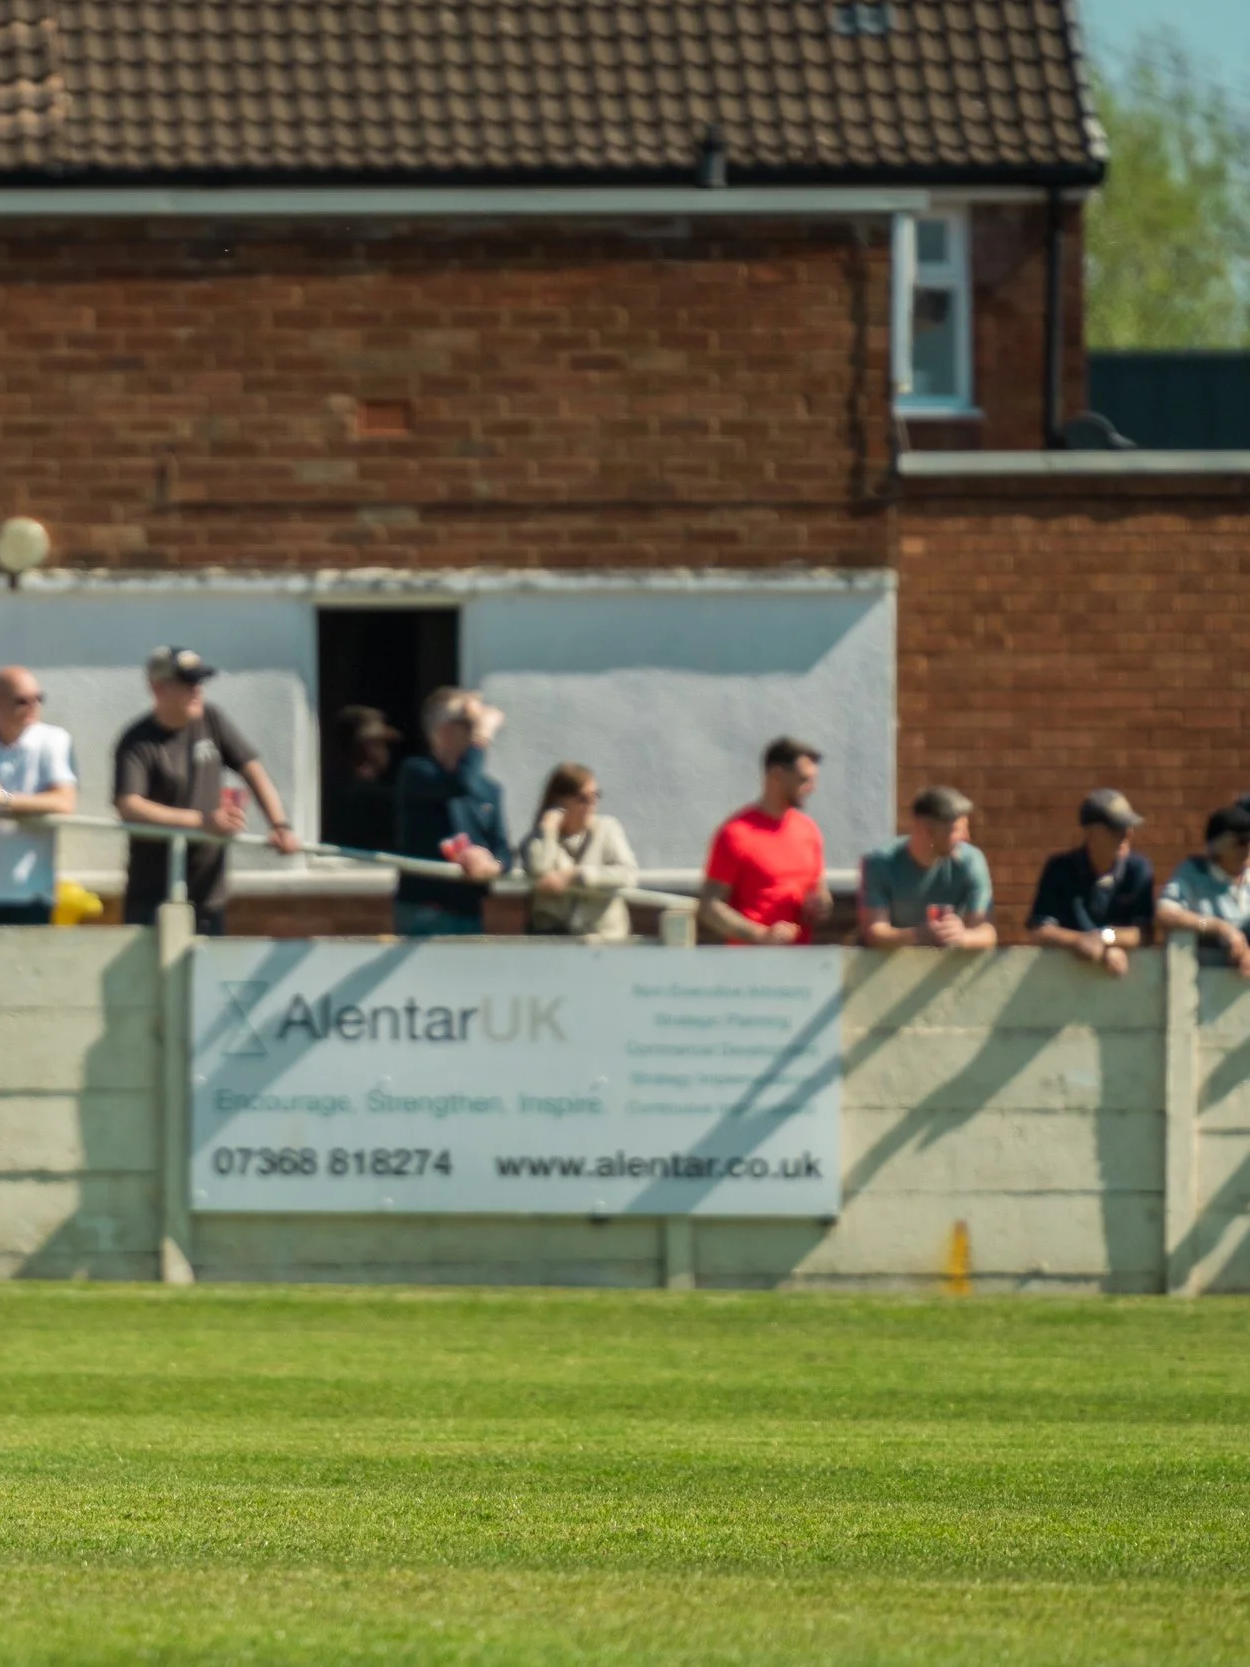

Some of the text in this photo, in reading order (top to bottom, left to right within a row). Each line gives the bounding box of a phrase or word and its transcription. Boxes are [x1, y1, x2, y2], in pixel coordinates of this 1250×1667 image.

[276, 991, 569, 1043] AlentarUK
[213, 1146, 454, 1177] 07368 818274
[494, 1150, 824, 1179] www.alentar.co.uk
